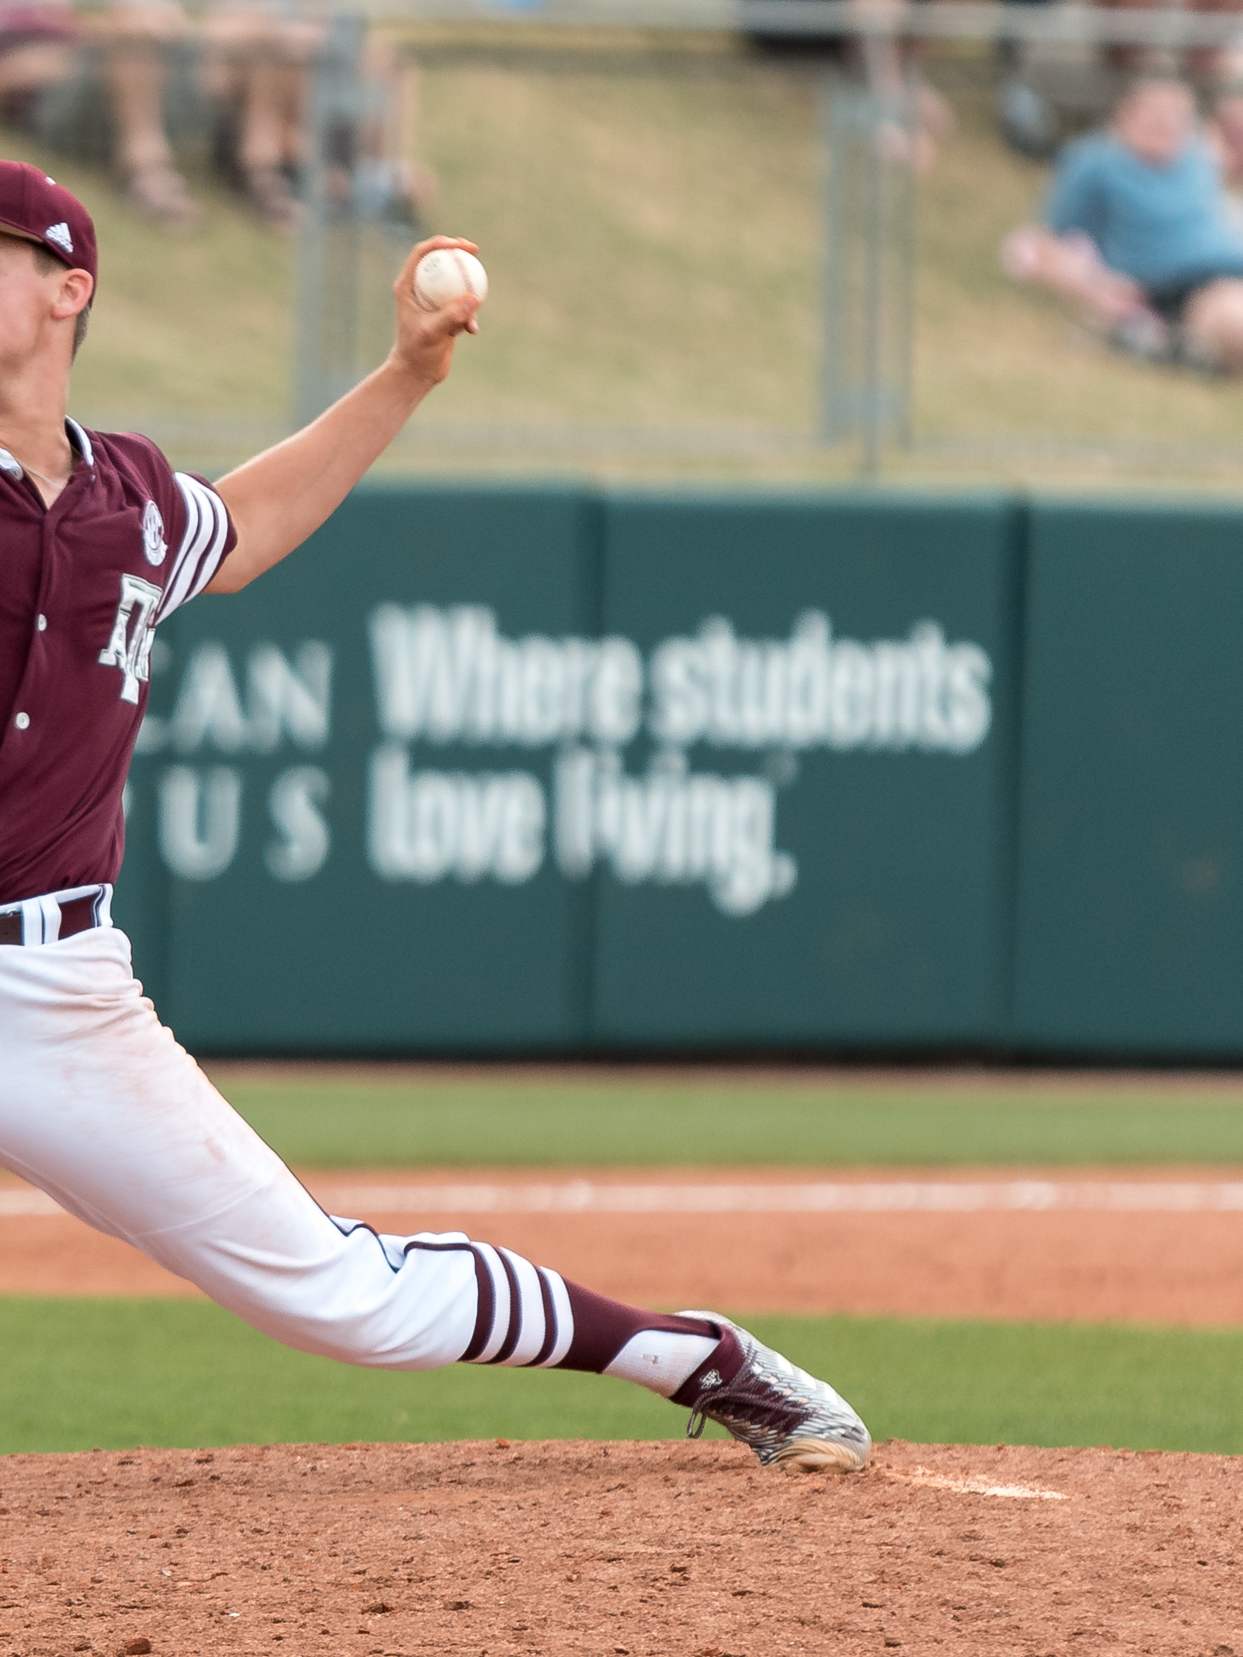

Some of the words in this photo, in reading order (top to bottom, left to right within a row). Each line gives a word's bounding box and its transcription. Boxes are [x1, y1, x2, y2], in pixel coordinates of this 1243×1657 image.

[369, 603, 644, 750] Where
[649, 608, 993, 756] students
[367, 744, 546, 886] love
